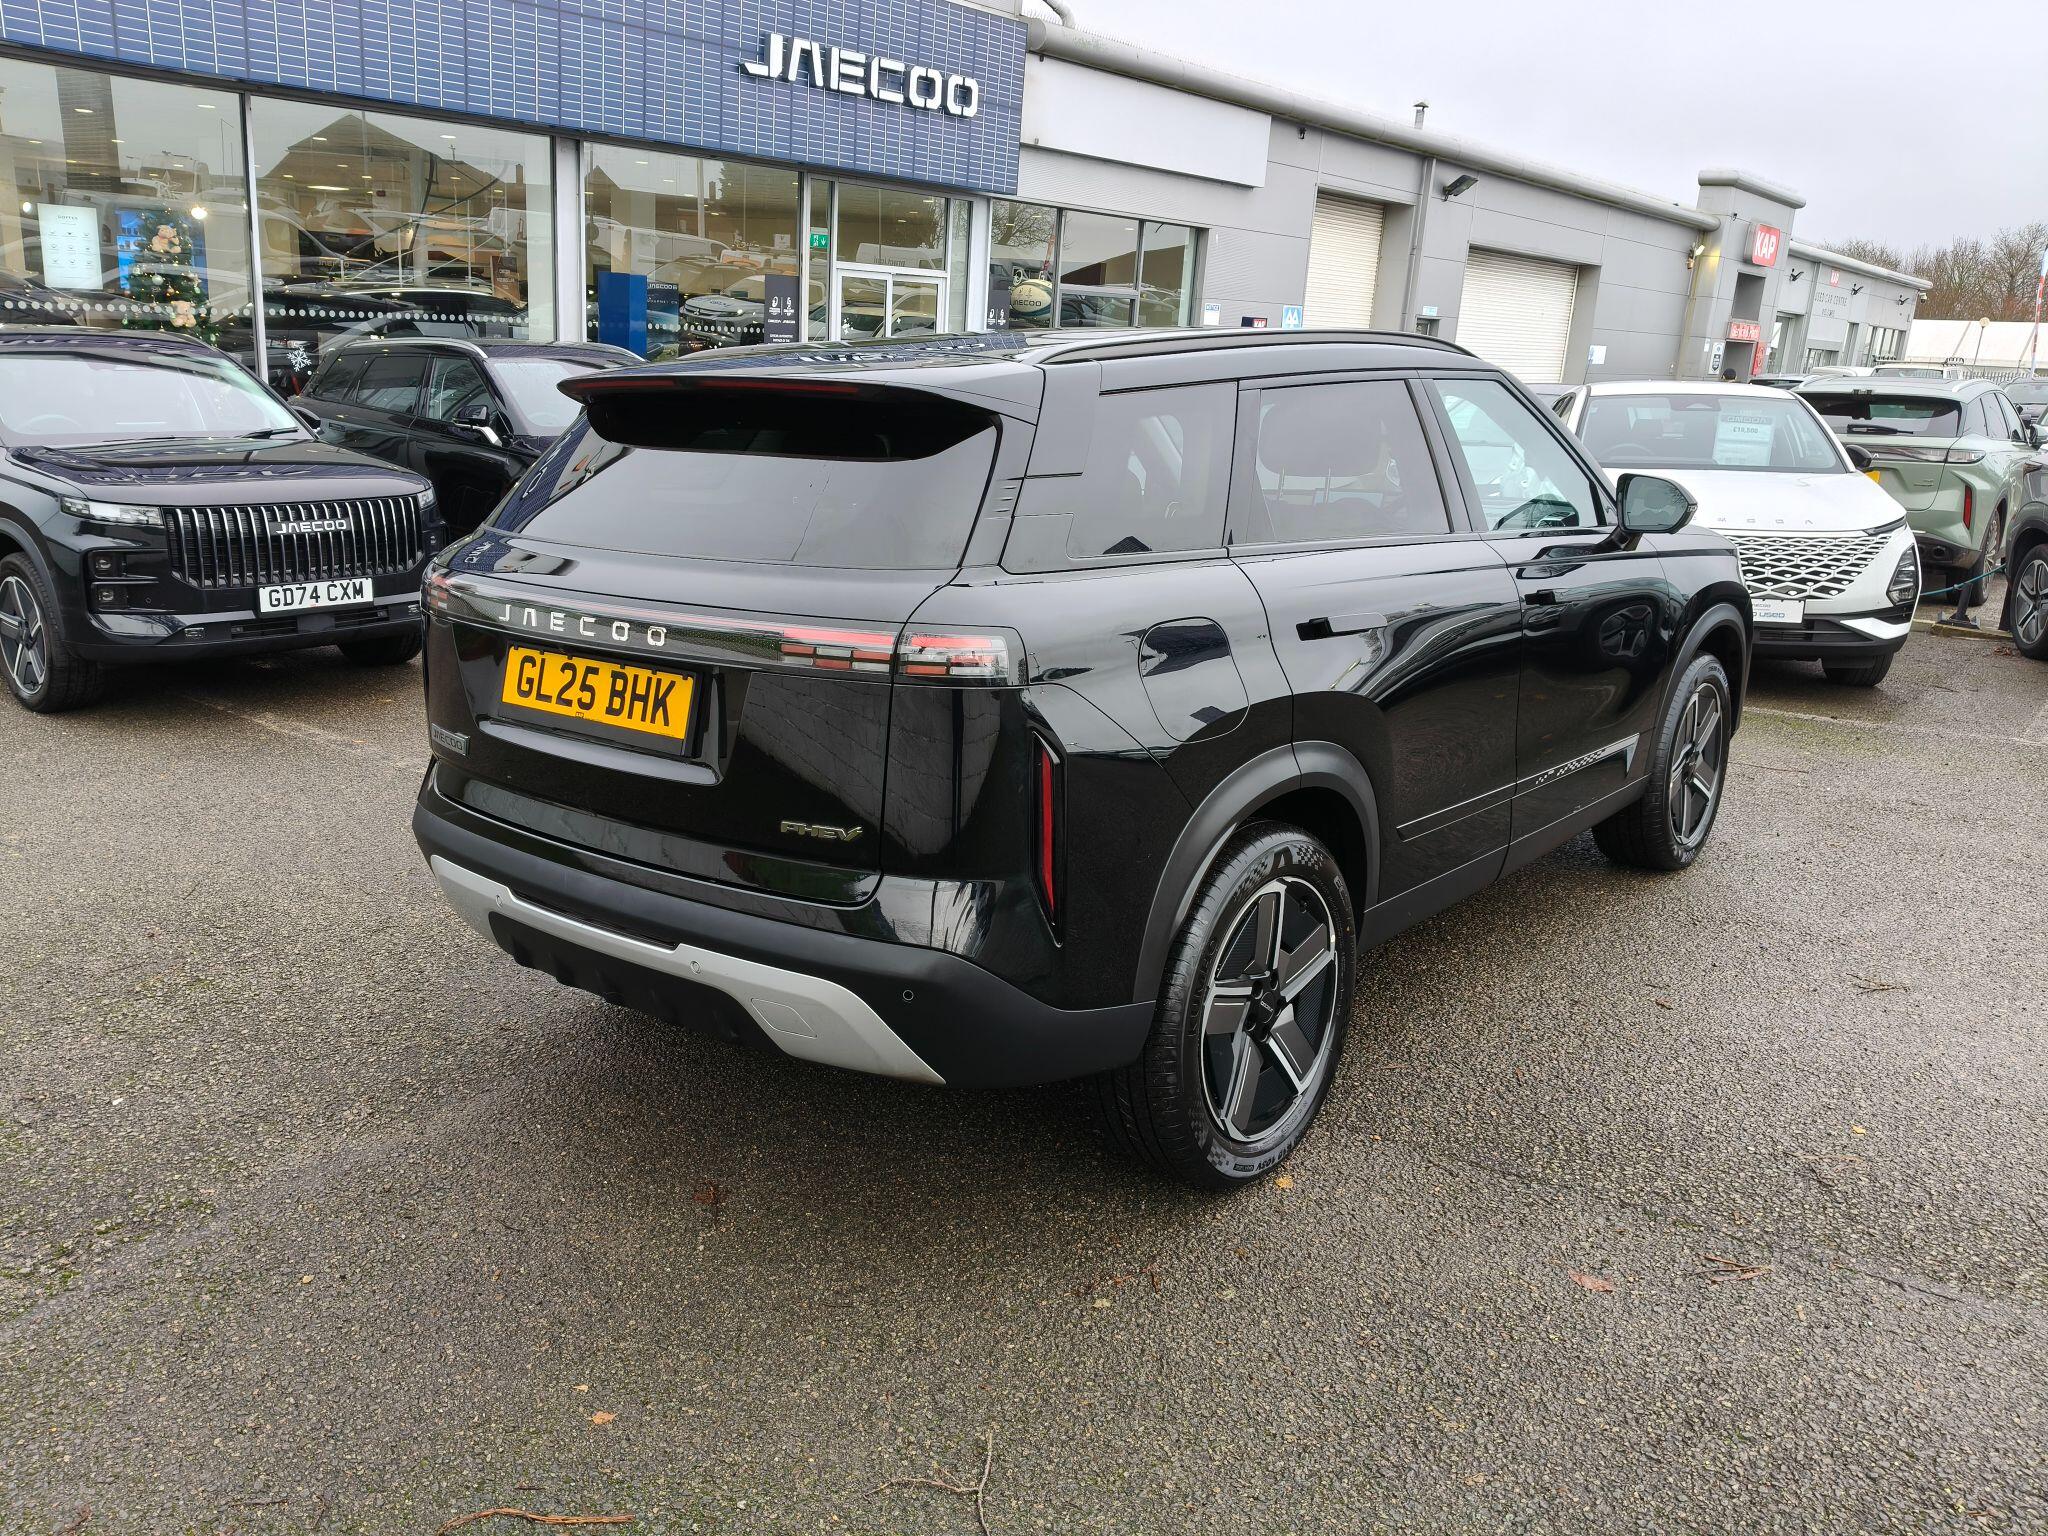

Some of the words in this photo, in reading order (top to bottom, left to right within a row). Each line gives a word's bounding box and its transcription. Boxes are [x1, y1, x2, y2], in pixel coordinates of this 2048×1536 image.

[740, 33, 979, 117] JAECOO
[1755, 231, 1777, 259] KAP
[276, 519, 347, 534] JAECOO
[268, 585, 321, 608] GD74
[327, 581, 364, 602] CXM
[498, 604, 668, 647] JAECOO
[1759, 611, 1786, 619] USED
[516, 655, 600, 711] GL25
[605, 670, 677, 727] BHK
[780, 821, 863, 841] PHEV
